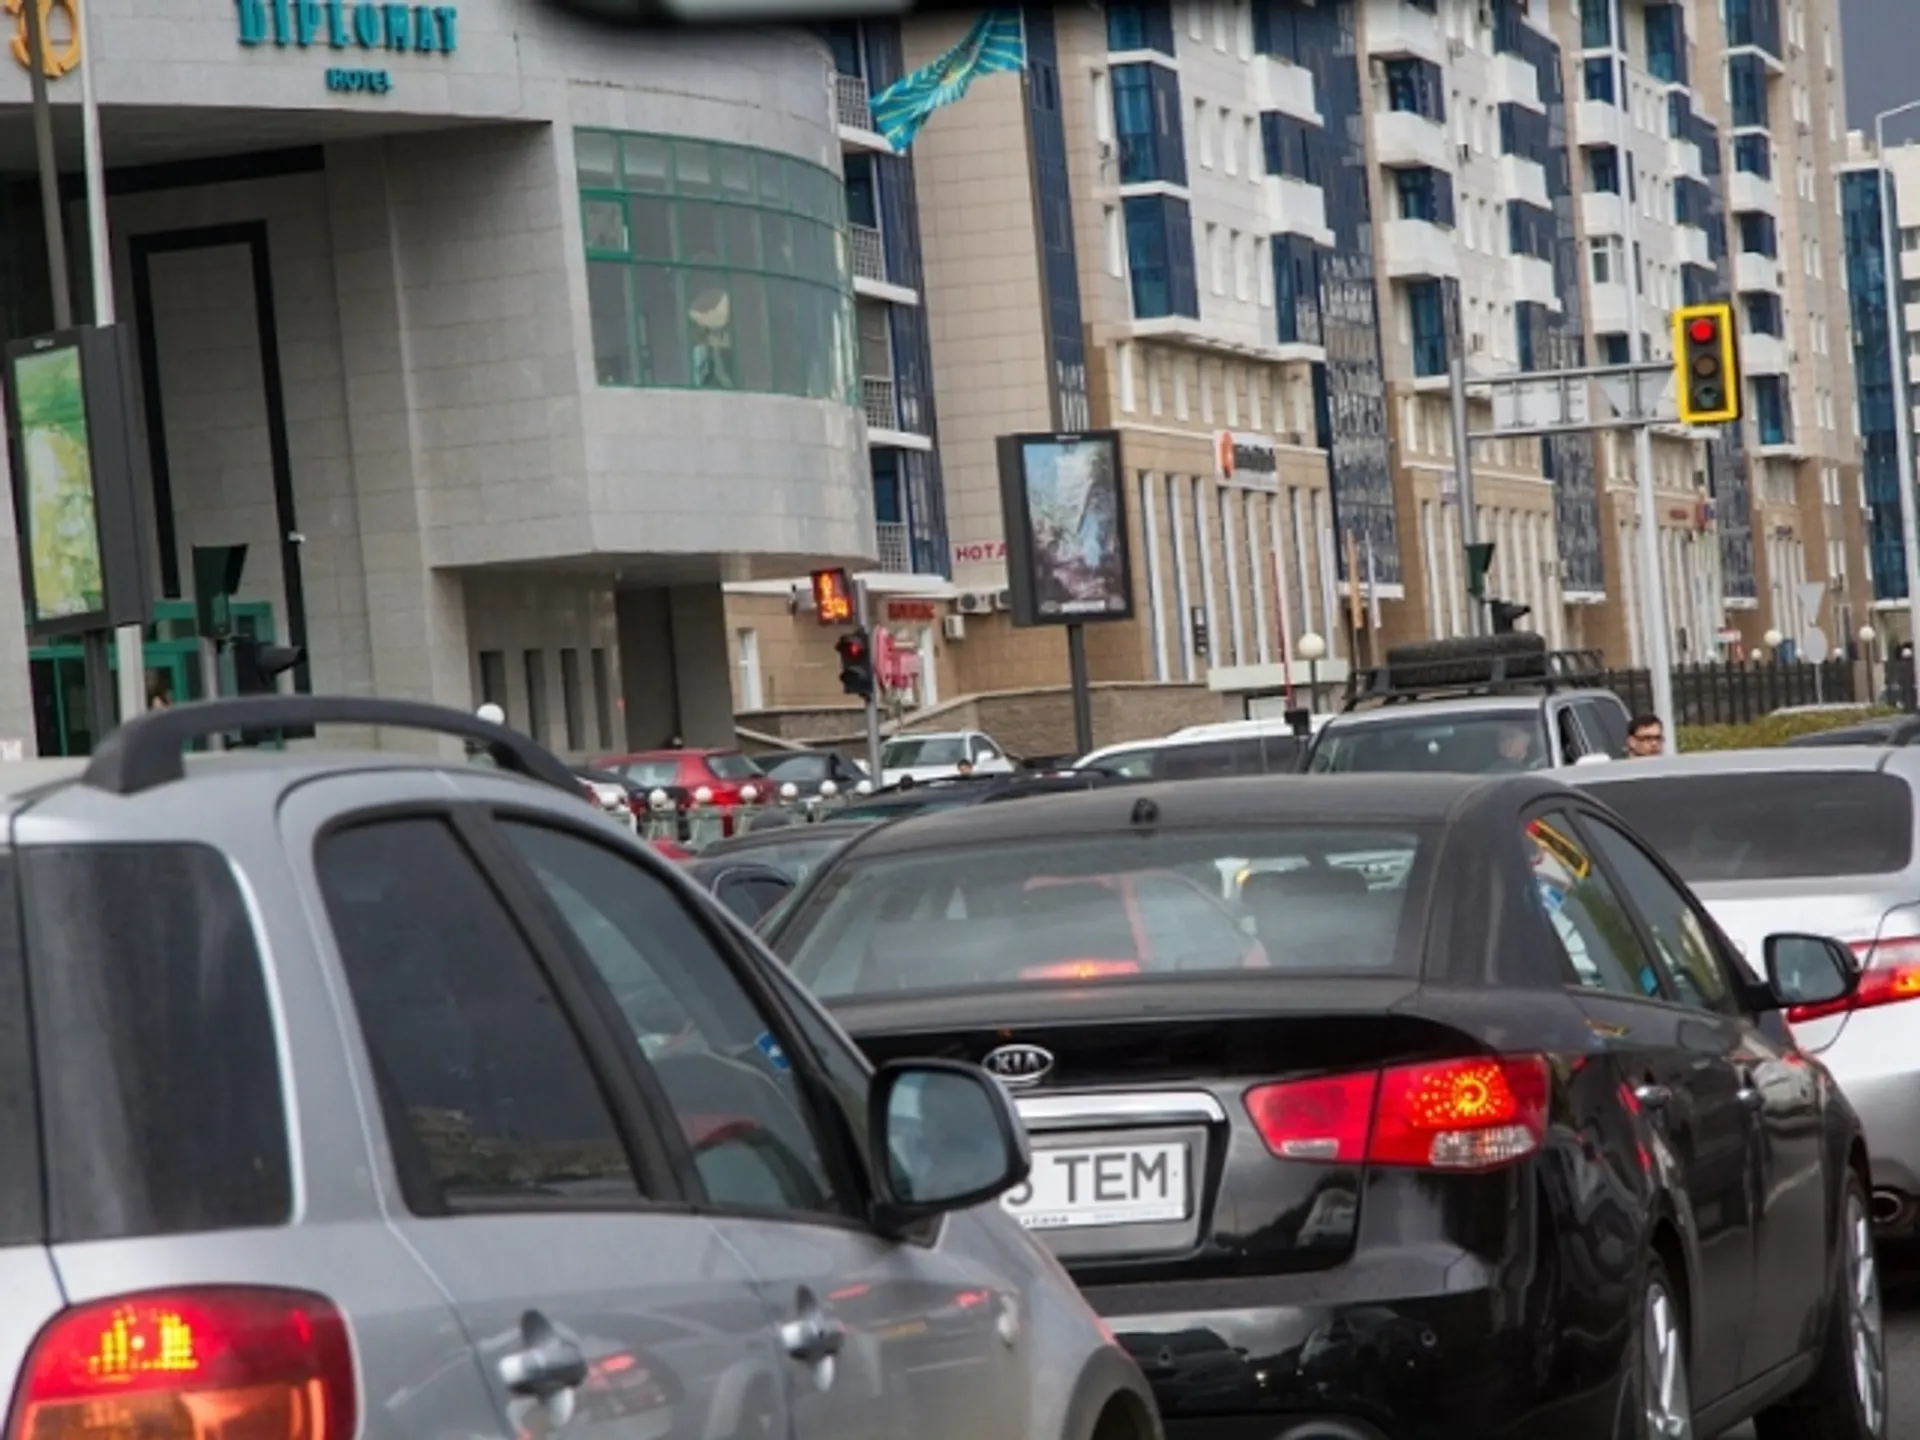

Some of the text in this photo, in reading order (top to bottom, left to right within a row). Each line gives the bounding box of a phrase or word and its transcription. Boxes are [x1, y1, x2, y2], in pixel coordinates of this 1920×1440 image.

[237, 0, 458, 53] DIPLOMAT
[326, 69, 393, 93] HOTEL
[995, 1051, 1040, 1073] KIA
[1053, 1151, 1168, 1204] TEM
